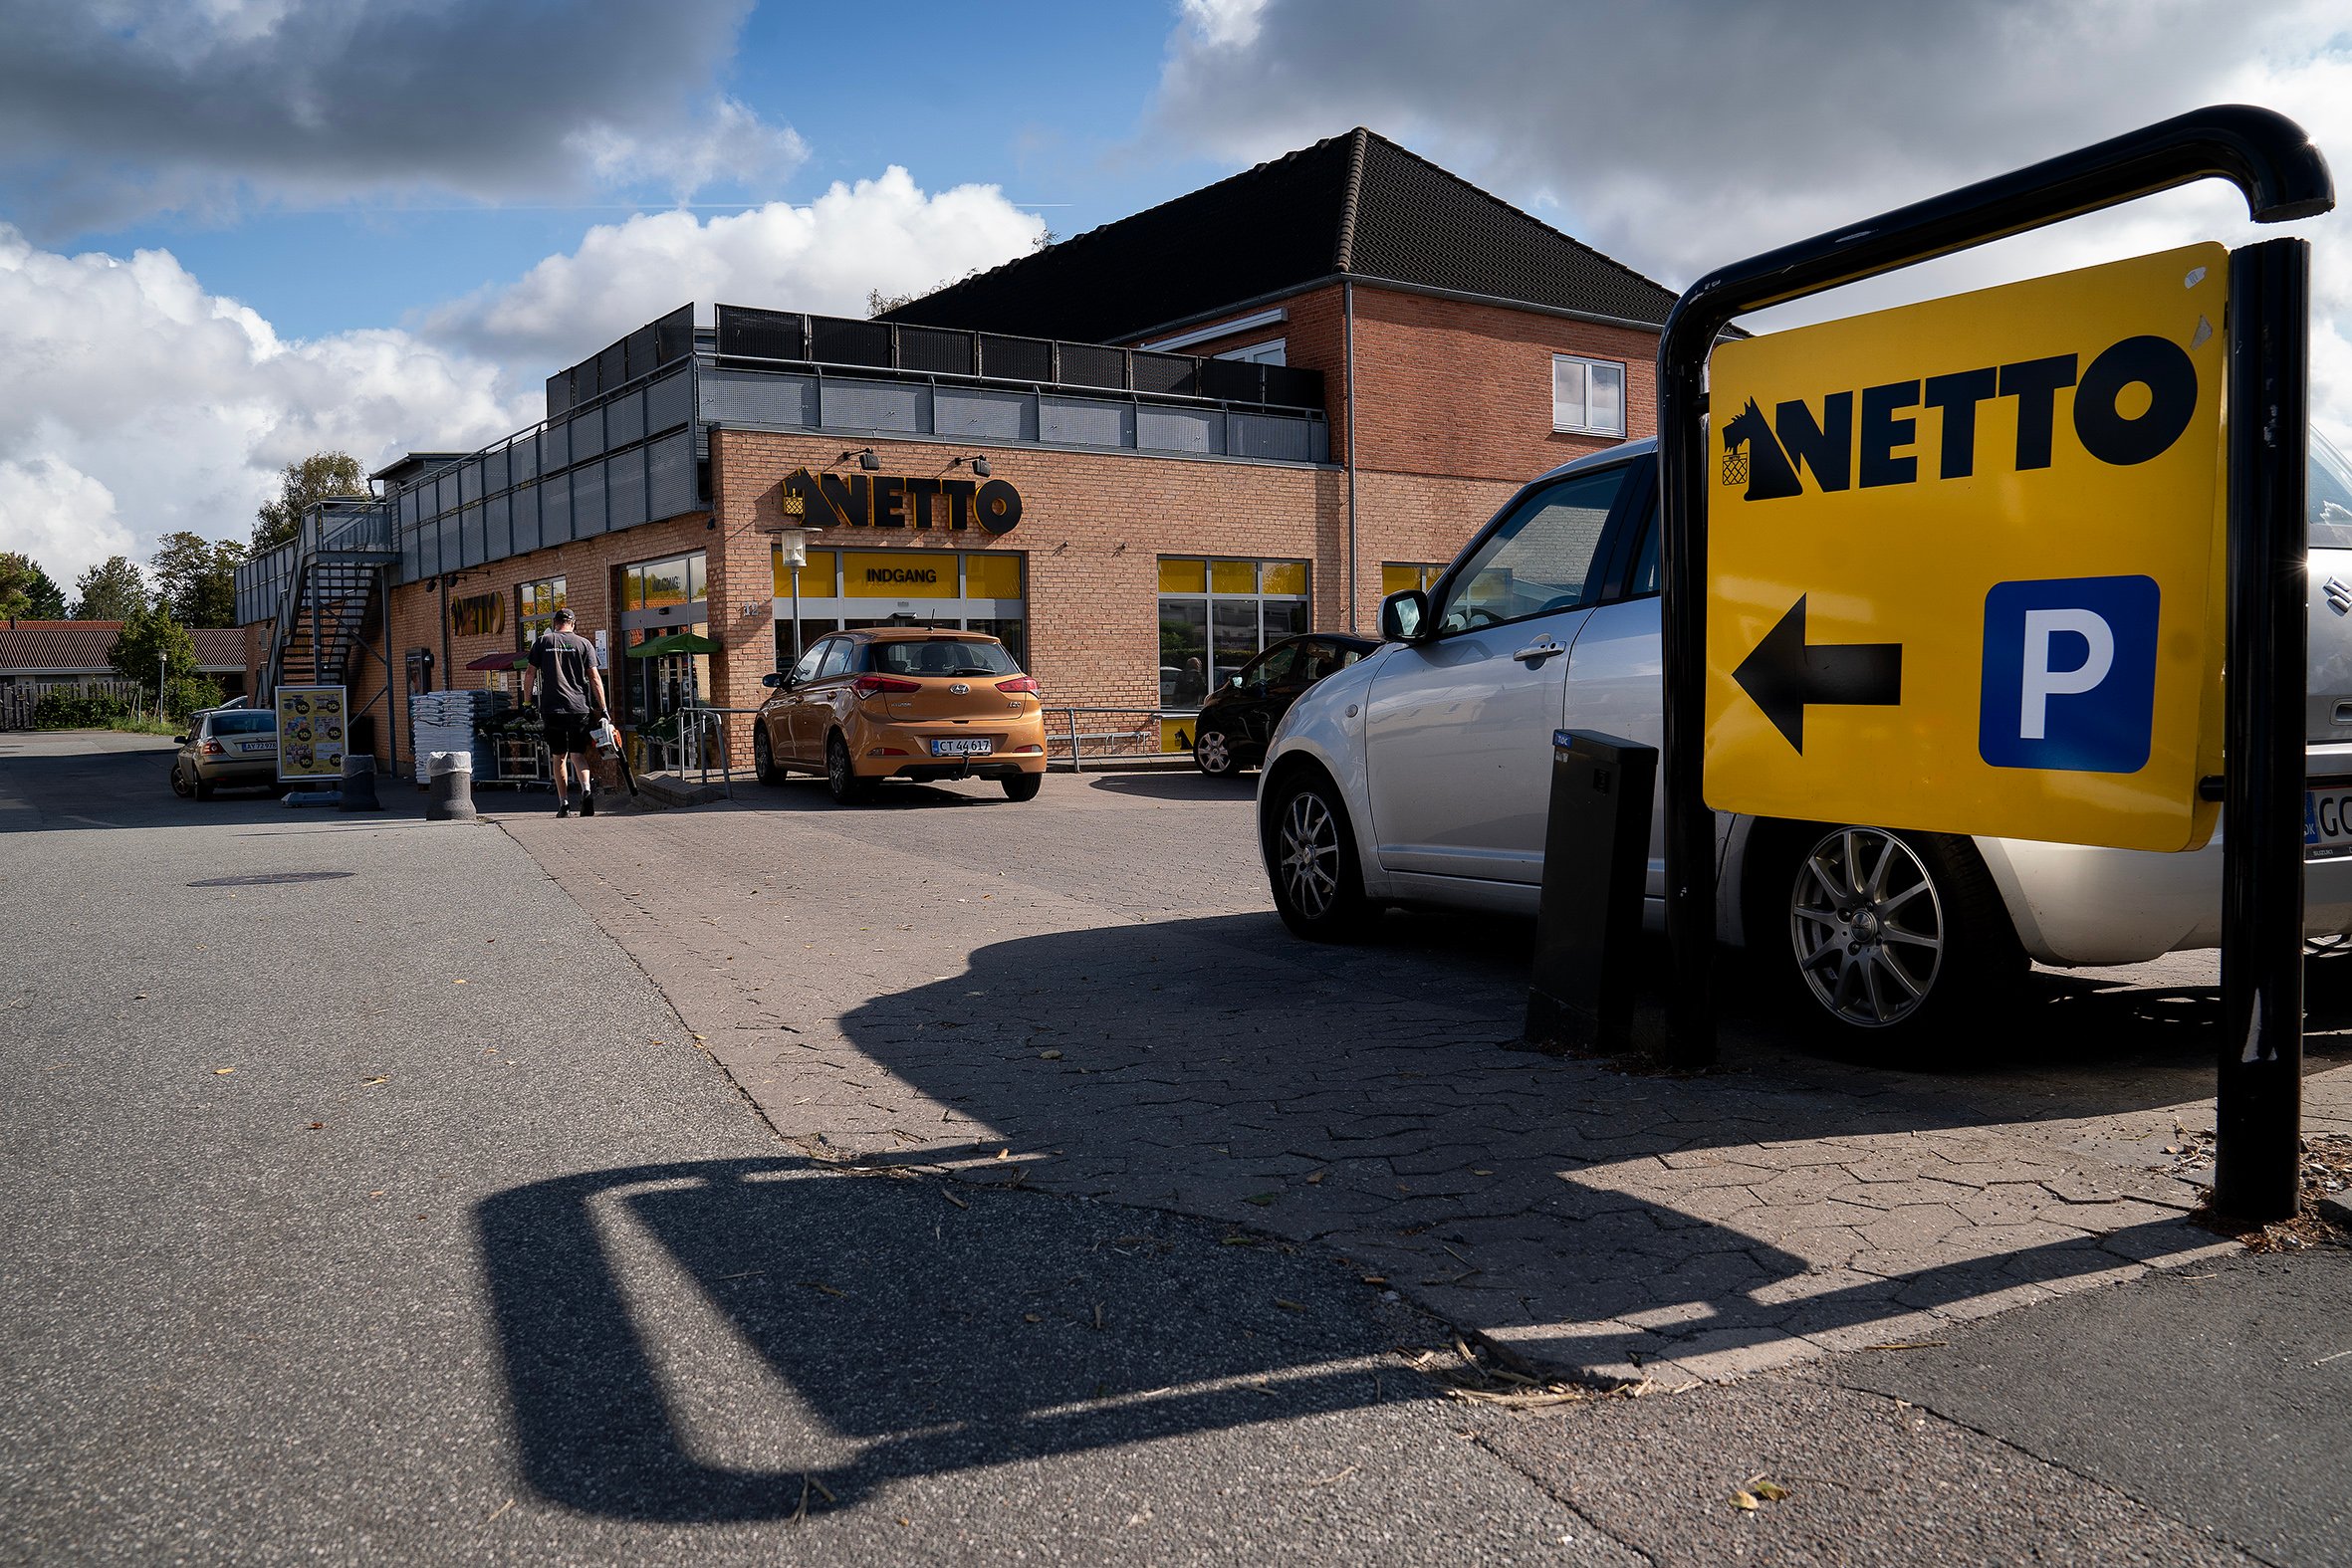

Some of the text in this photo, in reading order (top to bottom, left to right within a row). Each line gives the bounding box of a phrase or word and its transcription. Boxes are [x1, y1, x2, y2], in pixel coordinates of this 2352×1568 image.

[1745, 335, 2199, 503] NETTO
[800, 468, 1023, 535] NETTO
[867, 568, 937, 583] INDGANG
[744, 602, 759, 616] 12
[2019, 608, 2115, 739] P
[940, 740, 989, 752] CT 44 617
